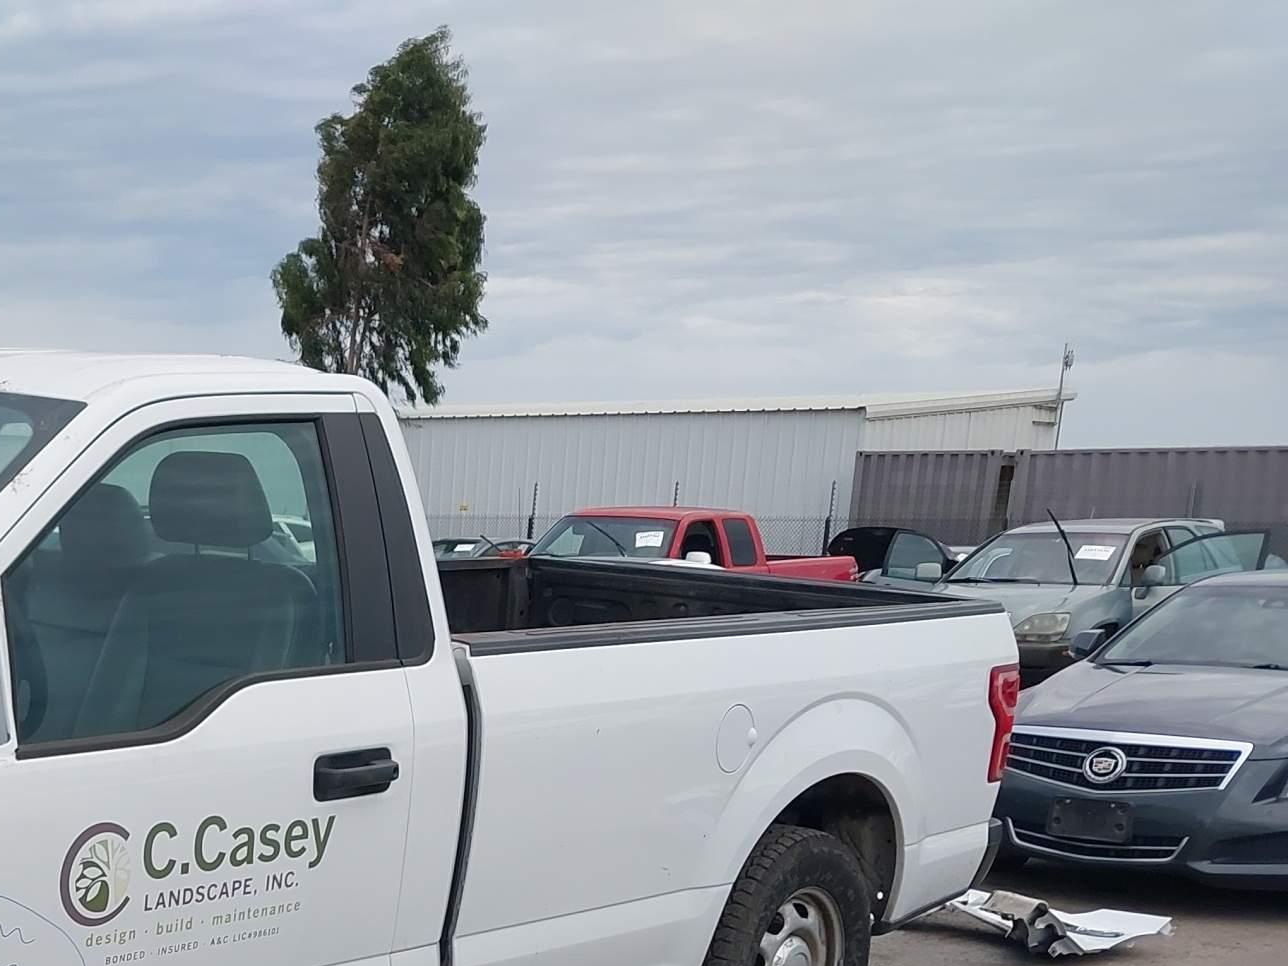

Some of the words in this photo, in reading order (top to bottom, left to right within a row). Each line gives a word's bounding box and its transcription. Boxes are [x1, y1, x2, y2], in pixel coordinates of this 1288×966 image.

[142, 815, 337, 880] C.Casey
[143, 877, 259, 911] LANDSCAPE,
[264, 871, 300, 892] INC.
[85, 929, 137, 948] design
[156, 917, 193, 935] build
[212, 901, 302, 927] maintenance
[105, 951, 146, 965] BONDED
[157, 941, 199, 956] INSURED
